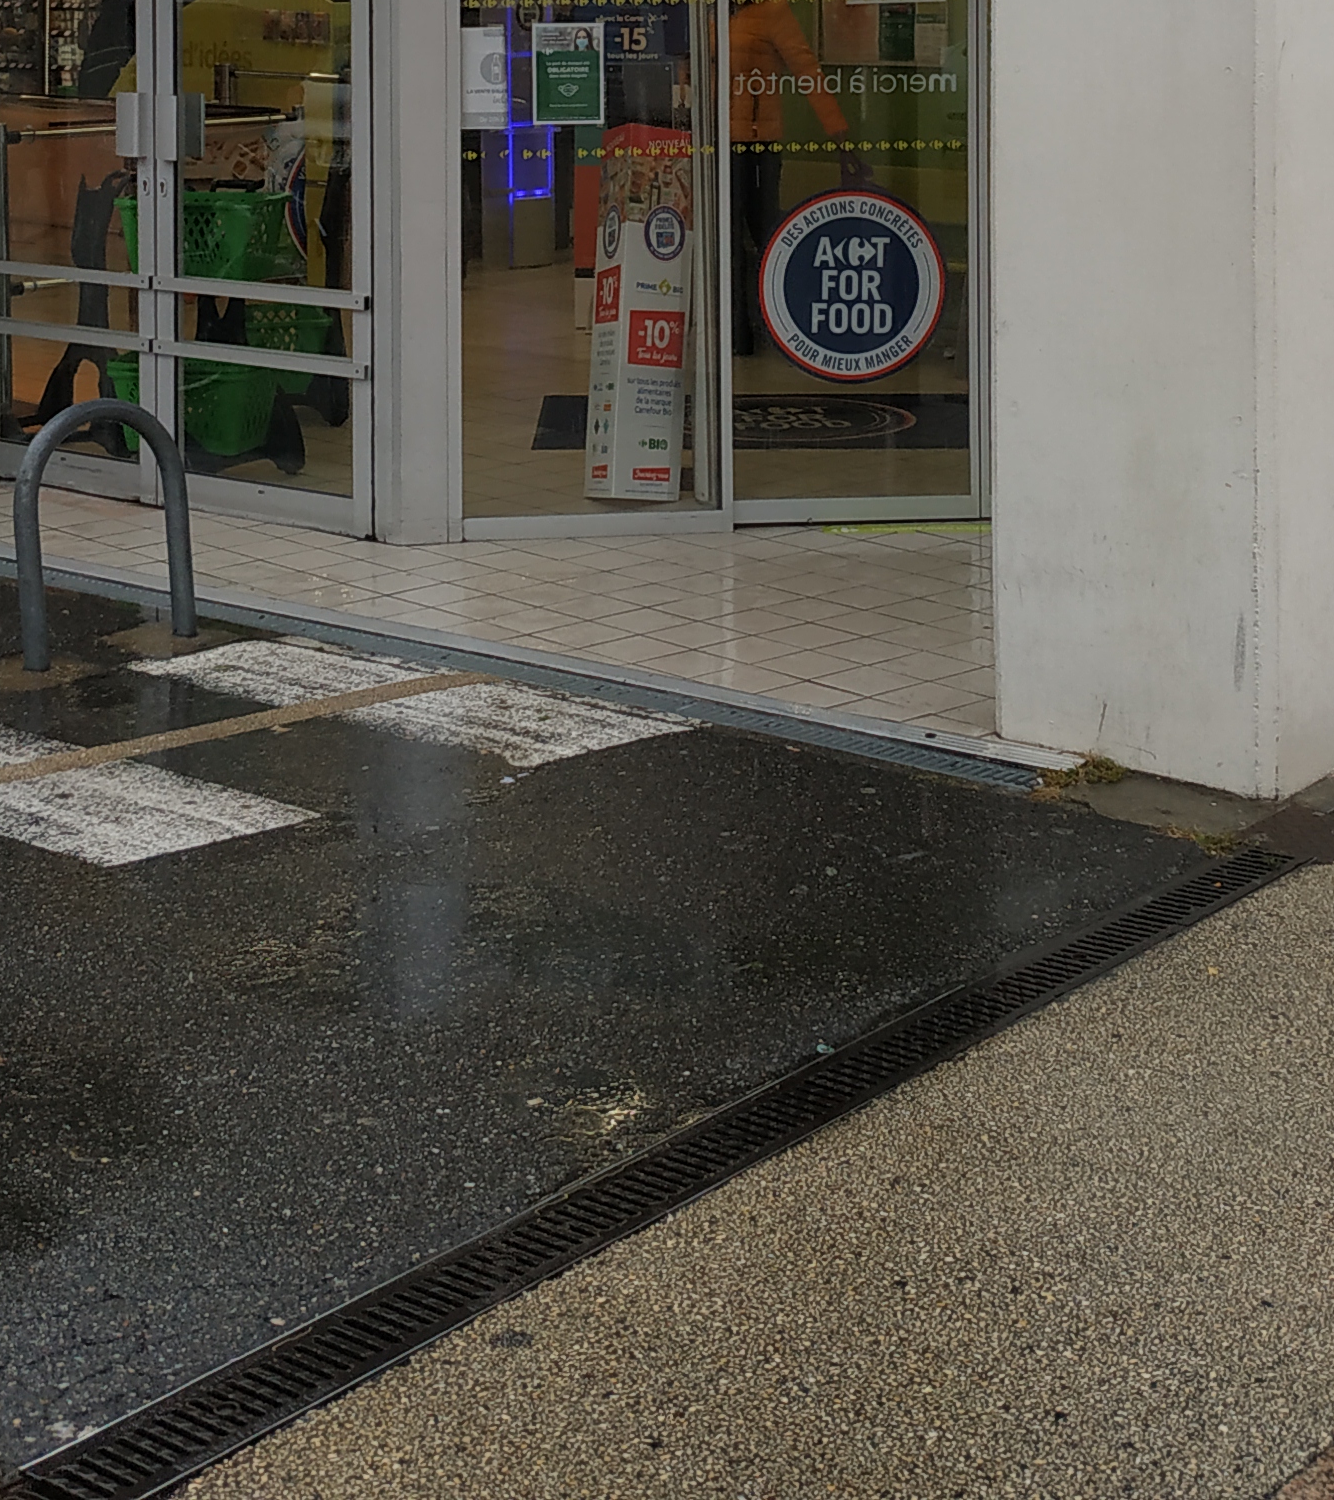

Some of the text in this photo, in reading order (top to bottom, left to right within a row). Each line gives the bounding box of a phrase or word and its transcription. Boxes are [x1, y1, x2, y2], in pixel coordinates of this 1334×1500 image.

[780, 200, 924, 249] DES ACTIONS CONCRÈTES
[821, 269, 881, 301] FOR
[810, 302, 893, 334] FOOD
[787, 333, 913, 372] POUR MIEUX MANGER
